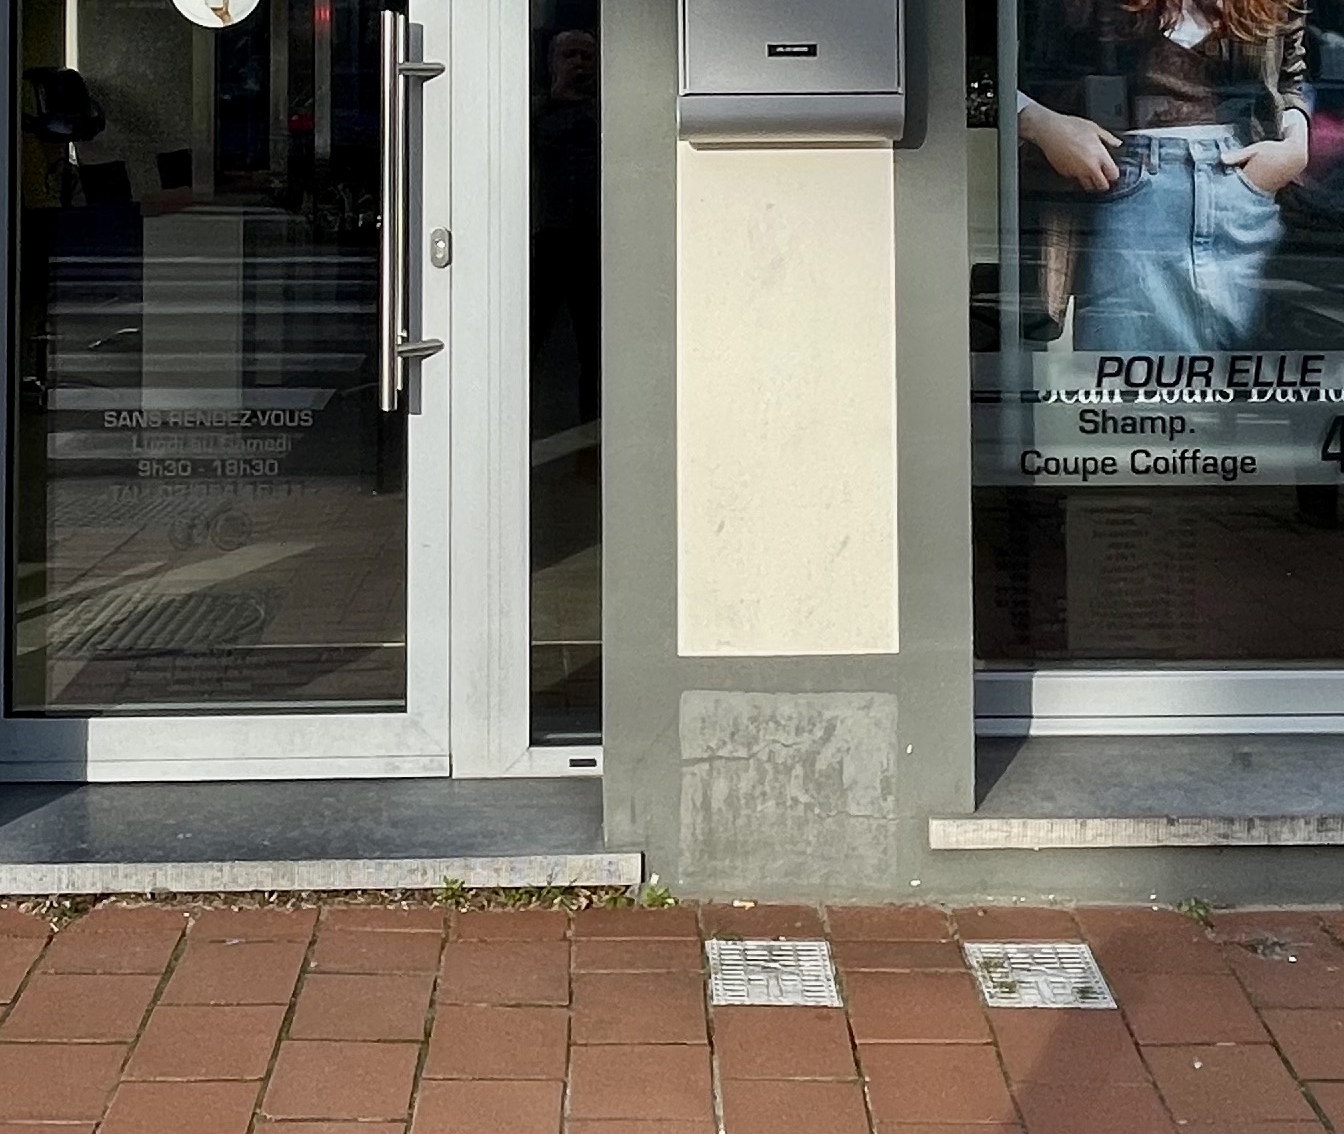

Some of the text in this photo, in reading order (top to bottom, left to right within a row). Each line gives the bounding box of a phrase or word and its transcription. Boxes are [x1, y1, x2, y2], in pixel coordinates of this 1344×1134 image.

[1096, 354, 1325, 388] POUR ELLE
[103, 410, 314, 428] SANS RENDEZ-VOUS
[1078, 409, 1195, 441] Shamp.
[138, 459, 192, 477] 9h30
[213, 459, 279, 477] 18h30
[1020, 448, 1257, 482] Coupe Coiffage
